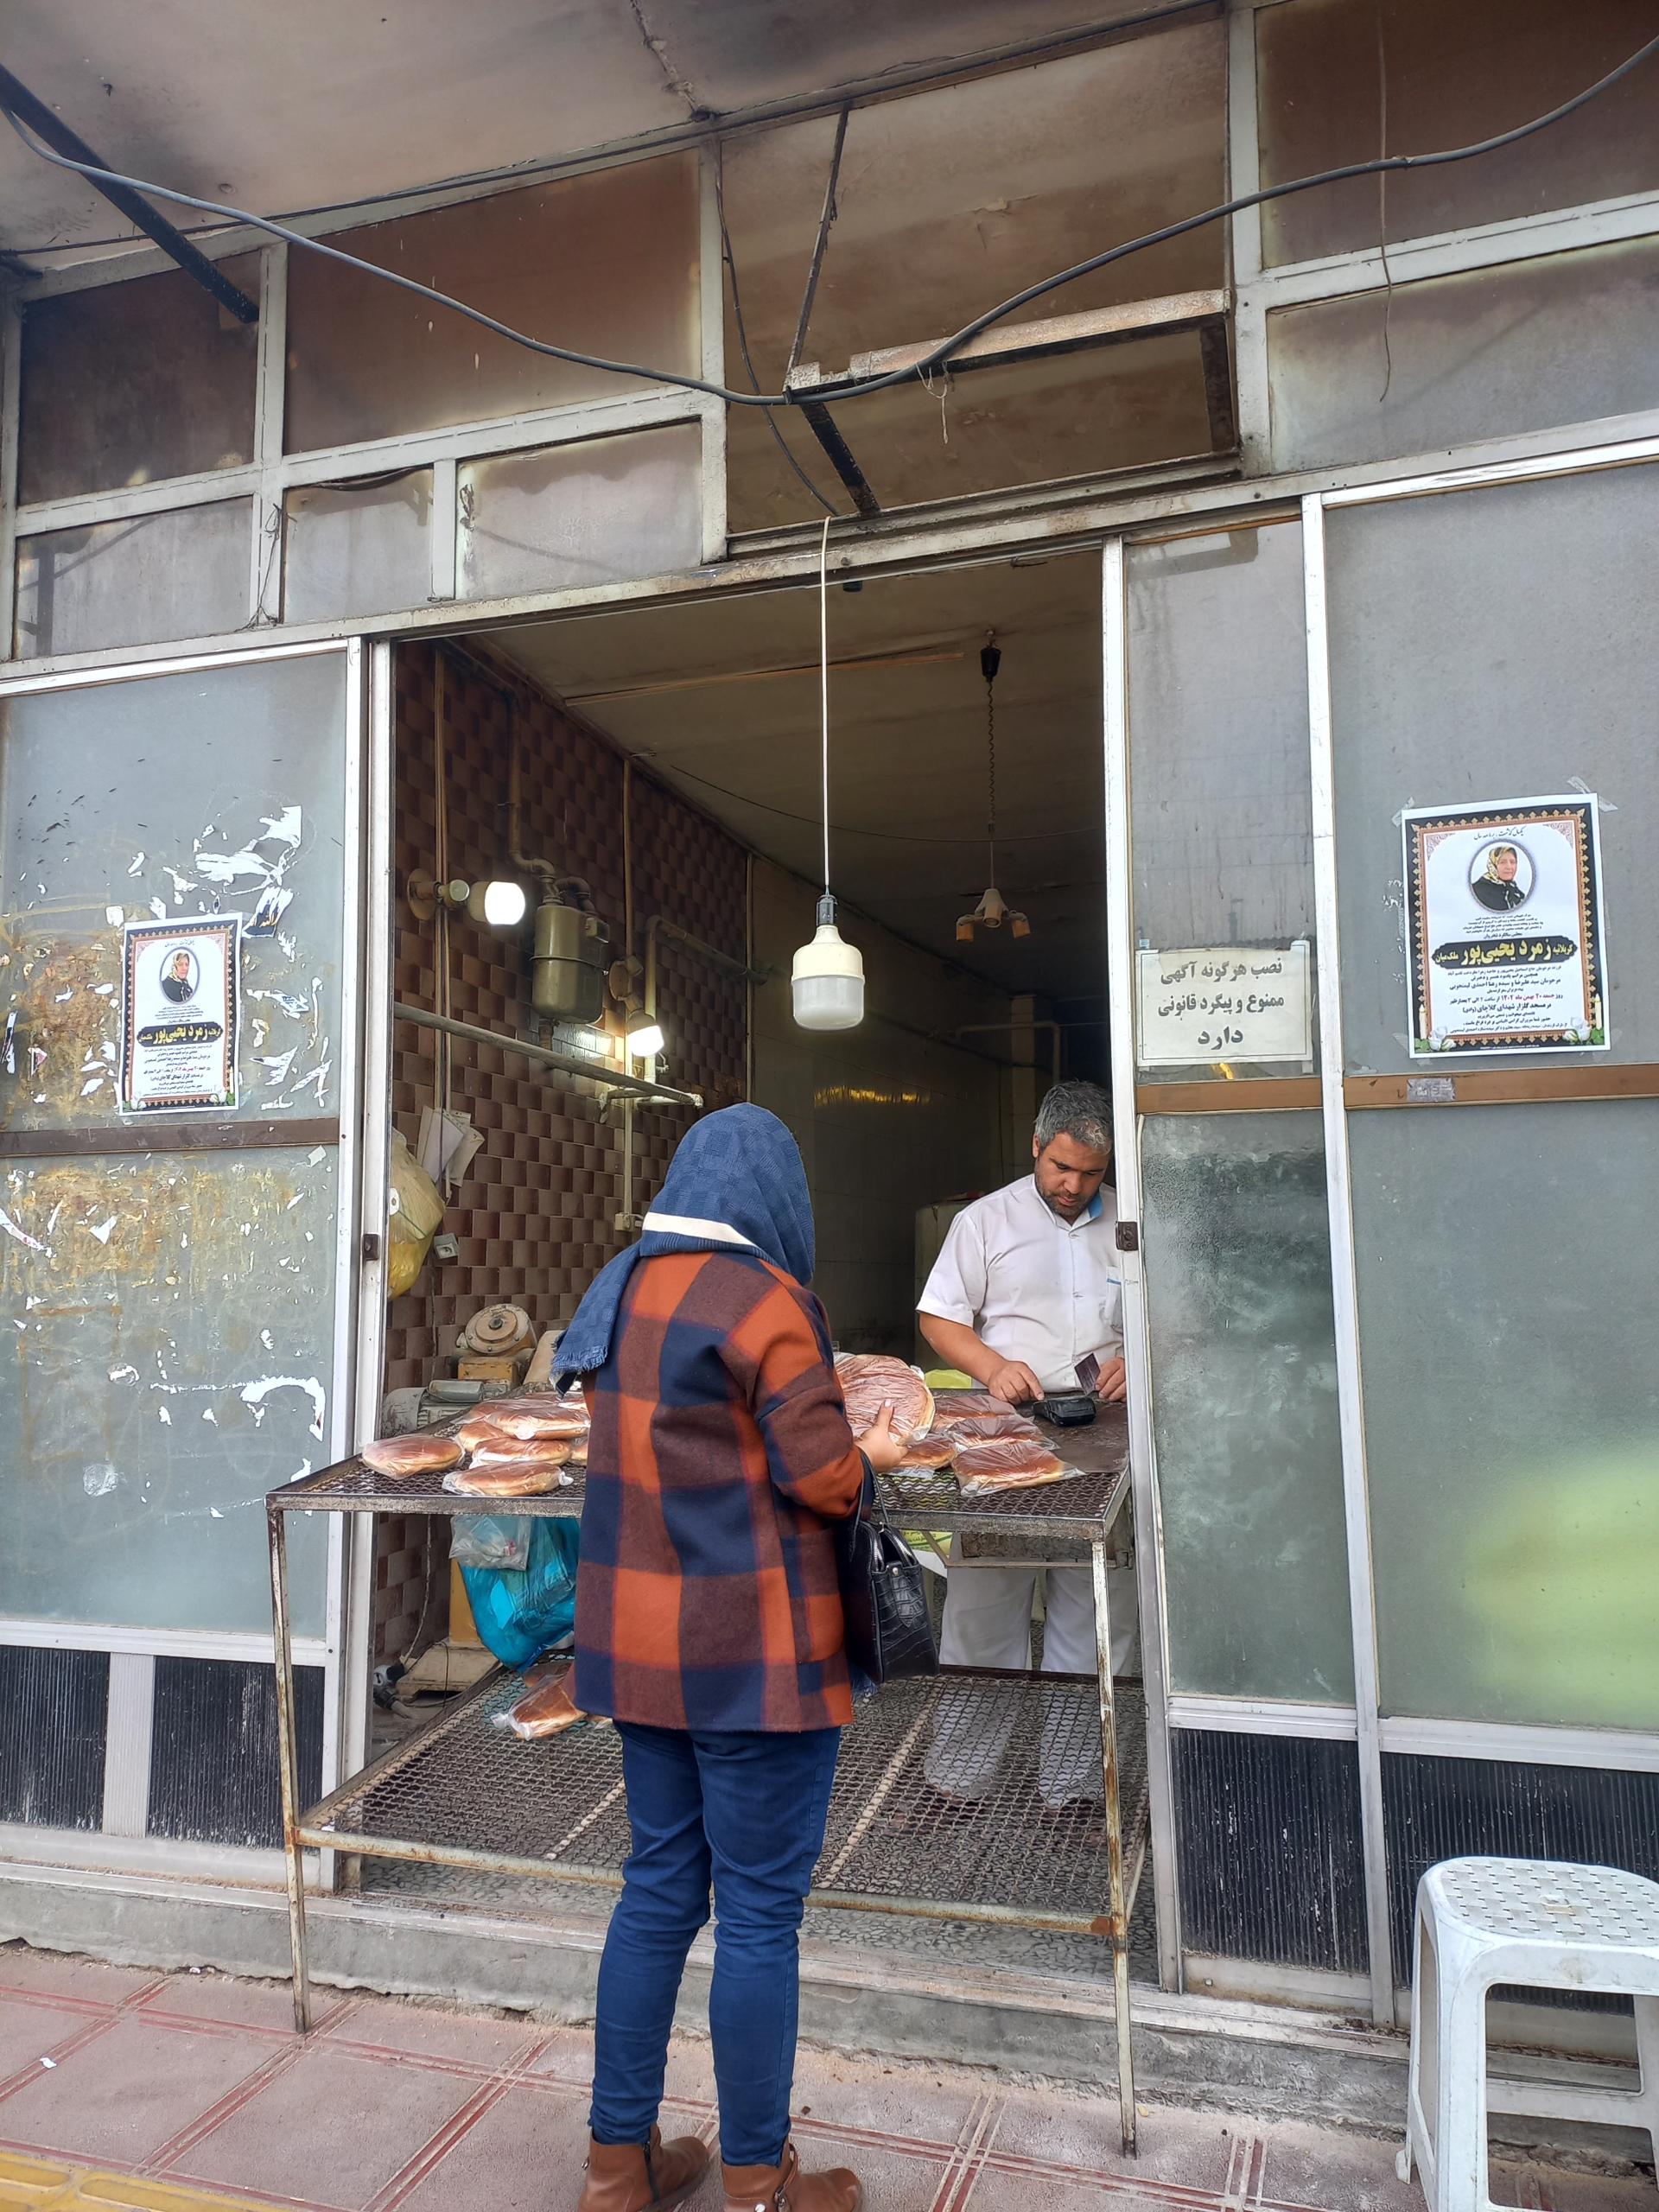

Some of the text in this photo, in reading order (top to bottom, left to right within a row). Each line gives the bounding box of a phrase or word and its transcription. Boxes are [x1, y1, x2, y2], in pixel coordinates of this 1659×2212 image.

[1519, 938, 1551, 962] زمرد
[1160, 960, 1198, 985] آگهی
[1250, 957, 1283, 980] نصب
[1158, 993, 1285, 1017] ممنوع و پیگرد قانونی
[1197, 1026, 1244, 1051] دارد
